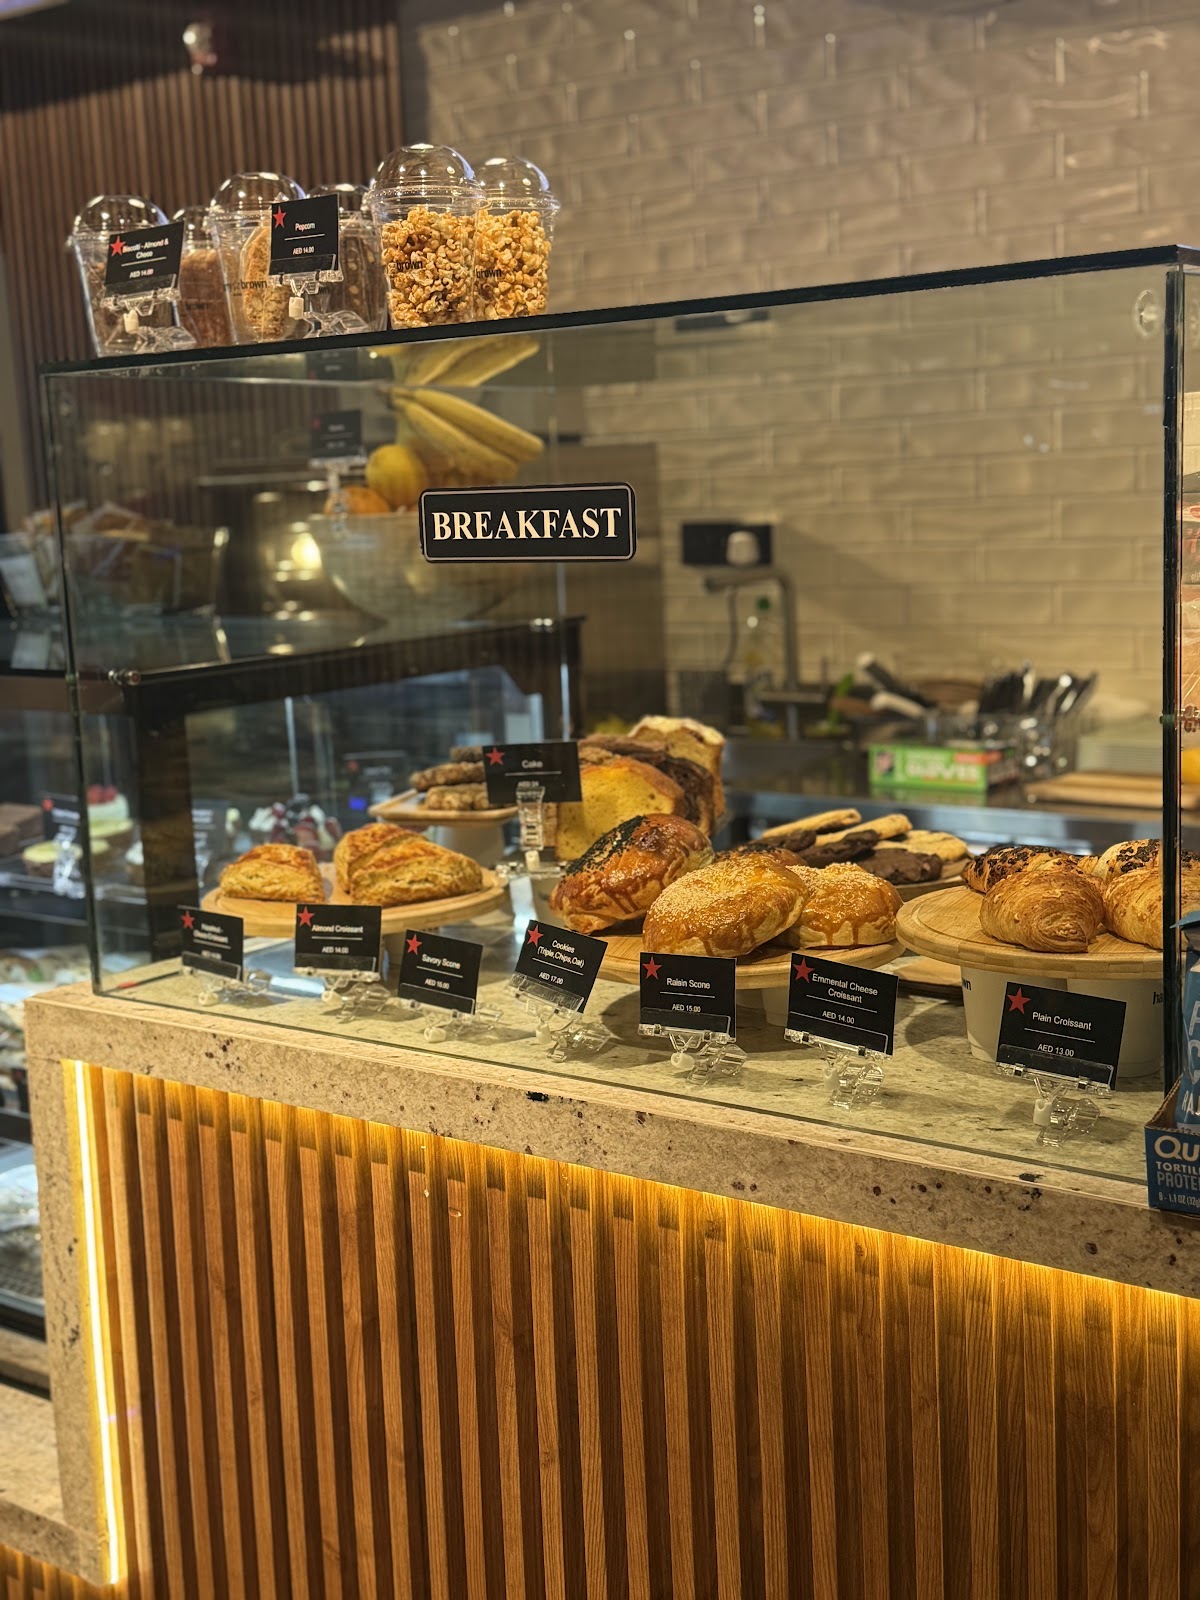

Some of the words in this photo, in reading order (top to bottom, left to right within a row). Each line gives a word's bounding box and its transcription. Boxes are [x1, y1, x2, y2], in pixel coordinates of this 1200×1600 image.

[295, 223, 315, 232] Popcorn
[144, 239, 164, 249] Almond
[292, 247, 302, 255] AED
[303, 246, 314, 254] 14.00
[136, 251, 153, 259] Choco
[476, 268, 501, 279] brown
[240, 279, 268, 289] brown
[431, 508, 622, 541] BREAKFAST
[521, 760, 543, 769] Cake
[311, 924, 334, 933] Almond
[335, 924, 364, 934] Croissant
[552, 940, 575, 954] Cookies
[422, 953, 441, 966] Savory
[442, 958, 460, 970] Scone
[424, 978, 436, 986] AED
[437, 980, 450, 990] 15.00
[538, 972, 549, 980] AED
[550, 975, 564, 985] 17.00
[666, 978, 687, 987] Raisin
[688, 979, 710, 989] Scone
[812, 973, 848, 989] Emmental
[849, 982, 878, 996] Cheese
[828, 988, 862, 1004] Croissant
[822, 1010, 836, 1019] AED
[838, 1014, 855, 1024] 14.00
[1032, 1011, 1052, 1023] Plain
[1053, 1015, 1092, 1030] Croissant
[1037, 1043, 1054, 1053] AED
[1055, 1047, 1074, 1057] 13.00
[1154, 1135, 1200, 1162] QU
[1156, 1161, 1200, 1175] TORTIL
[1156, 1171, 1200, 1191] PROTE
[1177, 1195, 1186, 1204] OZ
